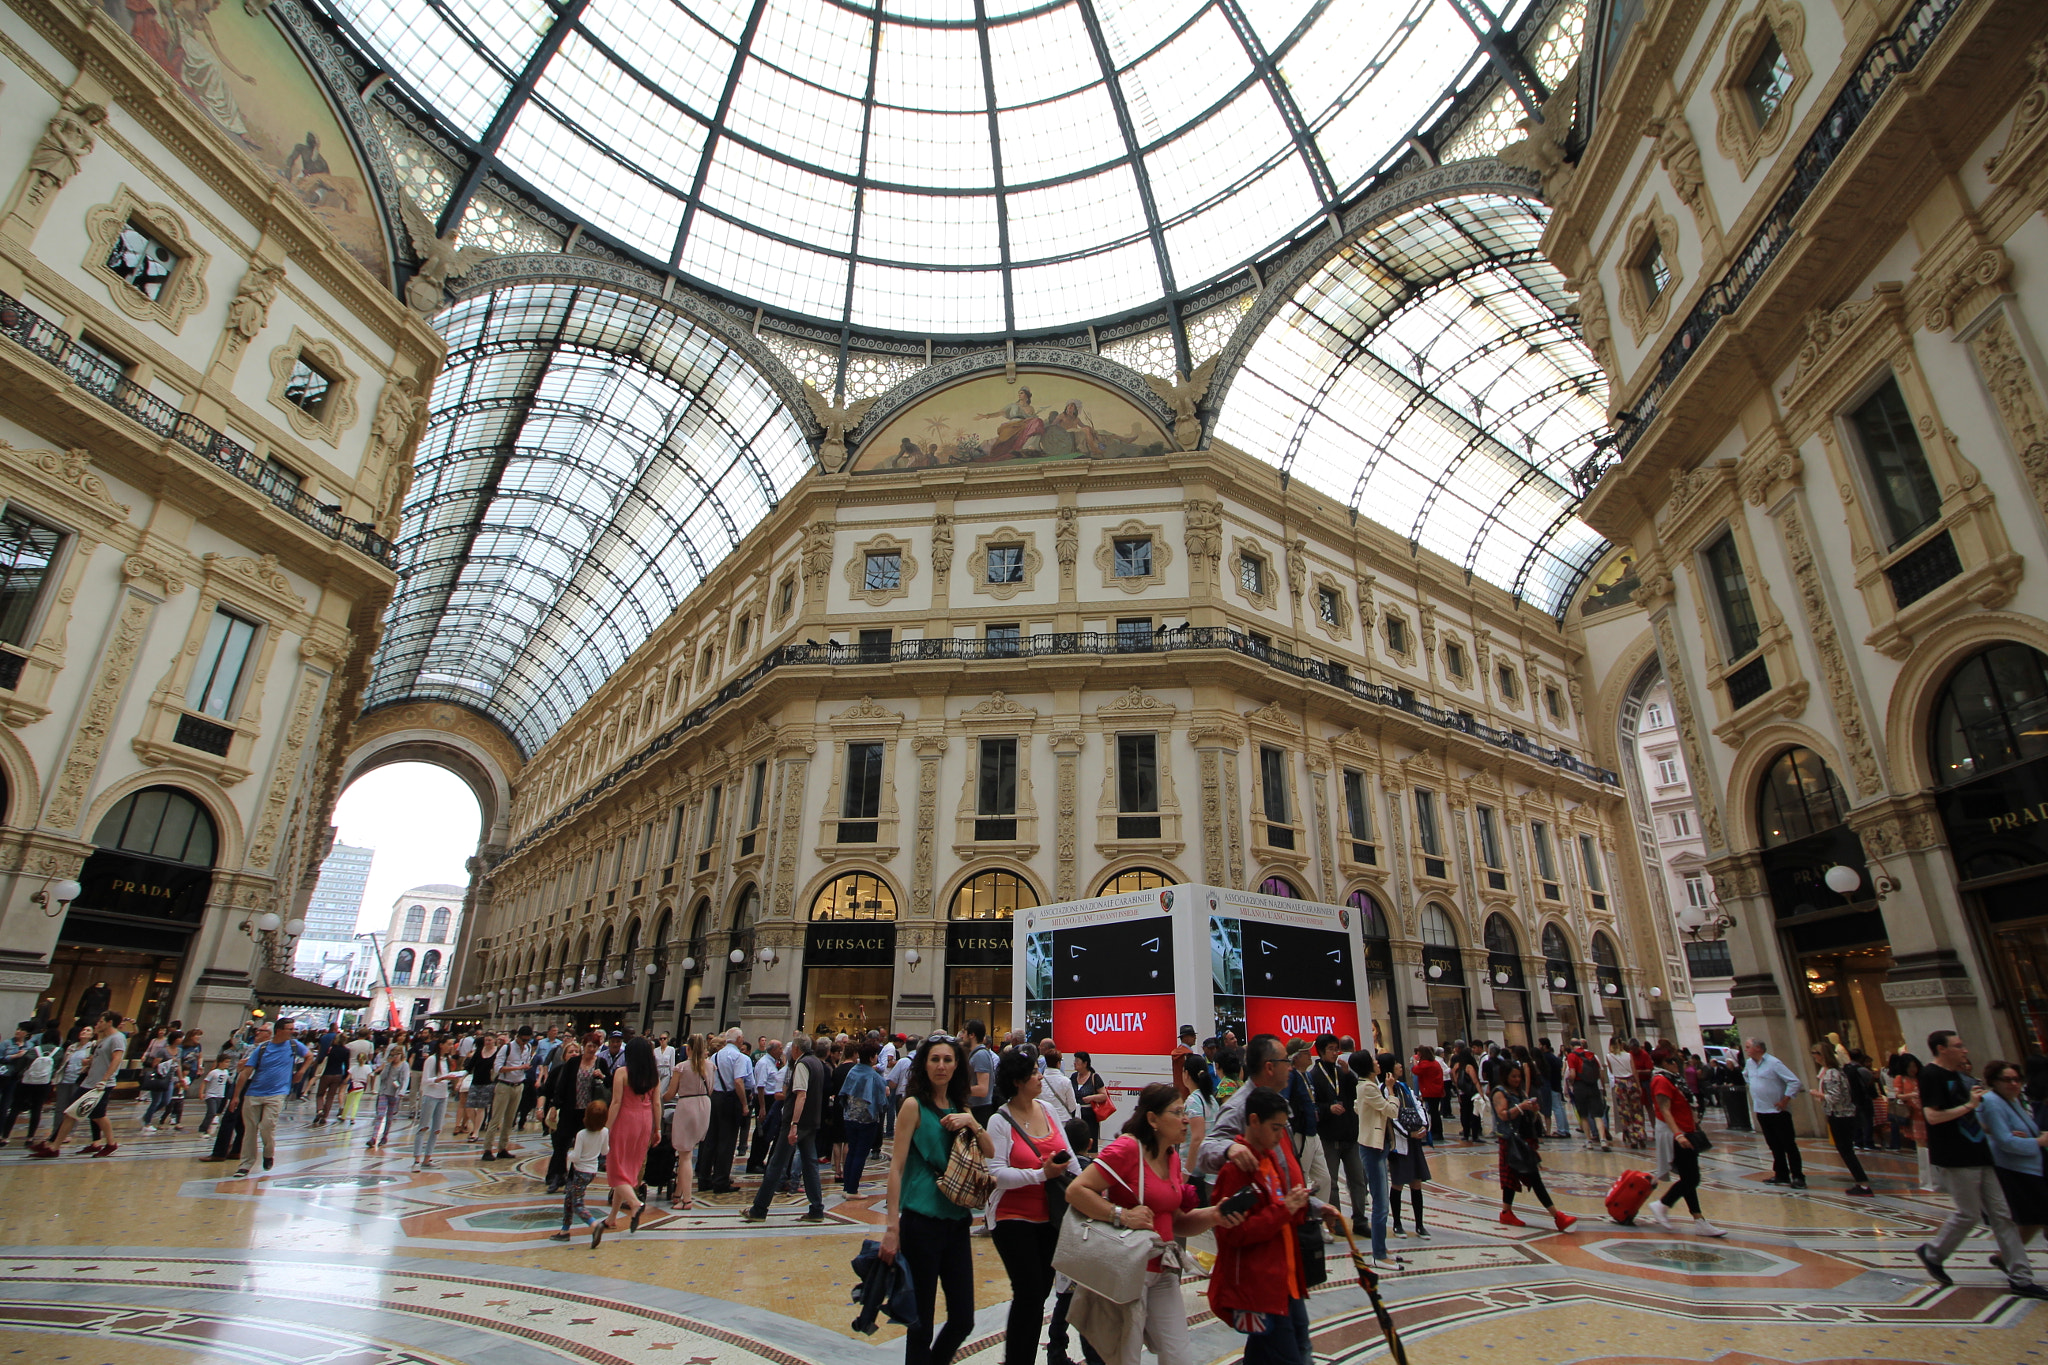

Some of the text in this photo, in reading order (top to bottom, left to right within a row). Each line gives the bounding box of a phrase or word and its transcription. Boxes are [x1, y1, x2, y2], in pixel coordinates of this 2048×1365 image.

[1793, 861, 1838, 885] PRAD
[111, 879, 172, 899] PRADA
[1039, 893, 1155, 917] ASSOCIAZIONE NAZIONALE CARABINIERI
[1224, 893, 1335, 915] ASSOCIAZIONE NAZIONALE CARABINIERI
[1239, 907, 1264, 917] MILANO
[1051, 916, 1075, 927] MILANO
[816, 938, 885, 950] VERSACE
[957, 938, 1013, 949] VERSA
[1085, 1012, 1147, 1034] QUALITA'
[1281, 1015, 1335, 1035] QUALITA'
